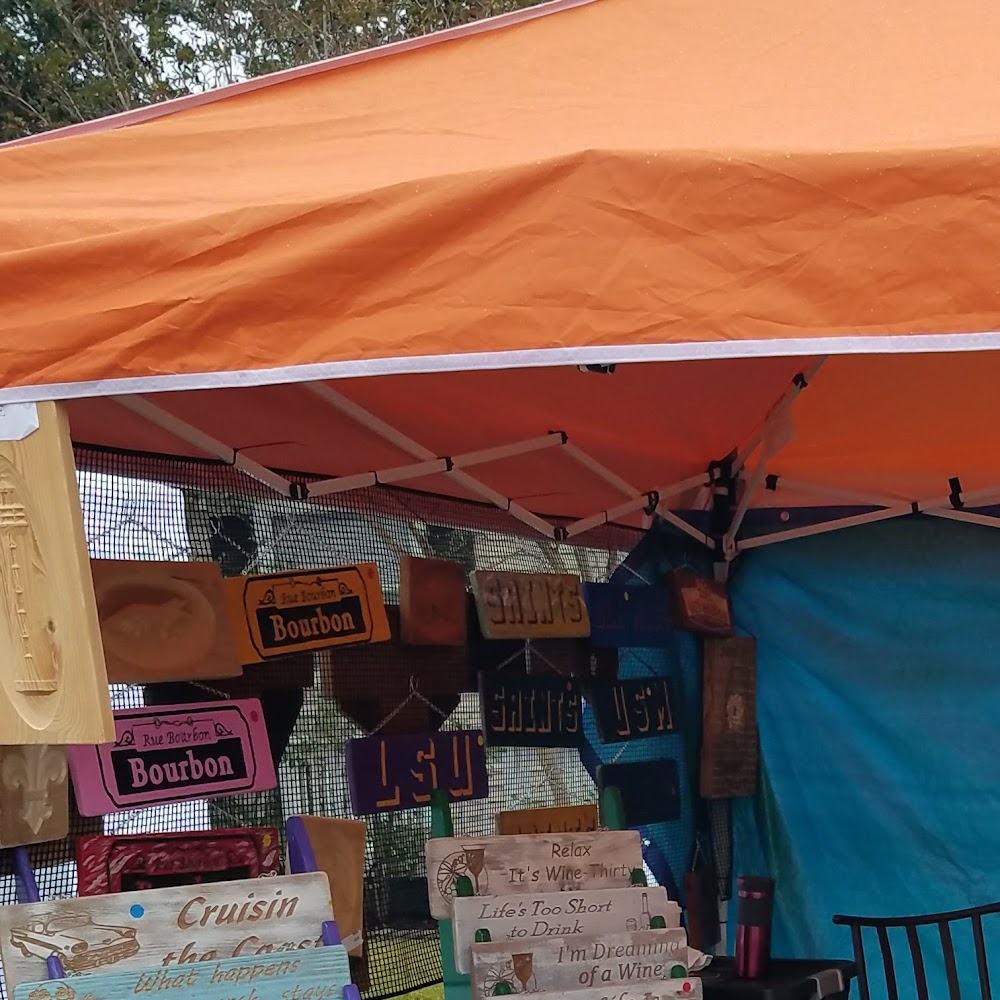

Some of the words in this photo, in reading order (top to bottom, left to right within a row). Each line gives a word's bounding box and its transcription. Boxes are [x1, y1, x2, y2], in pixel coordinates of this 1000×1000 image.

[488, 578, 584, 625] SAINTS
[269, 607, 356, 642] Bourbon
[491, 686, 578, 733] SAINTS
[142, 731, 166, 747] Rue
[167, 727, 212, 744] Bourbon
[127, 750, 234, 788] Bourbon
[375, 734, 474, 808] LSU
[552, 842, 592, 859] Relax
[509, 865, 540, 883] It's
[177, 890, 301, 930] Cruisin
[477, 902, 527, 920] Life's
[531, 900, 562, 918] Too
[565, 898, 612, 914] Short
[510, 925, 528, 938] to
[531, 919, 584, 937] Drink
[558, 945, 587, 963] I'm
[592, 941, 680, 961] Dreaming
[133, 966, 198, 995] What
[210, 959, 302, 986] happens
[578, 965, 599, 987] of
[601, 968, 612, 982] a
[618, 962, 663, 980] Wine
